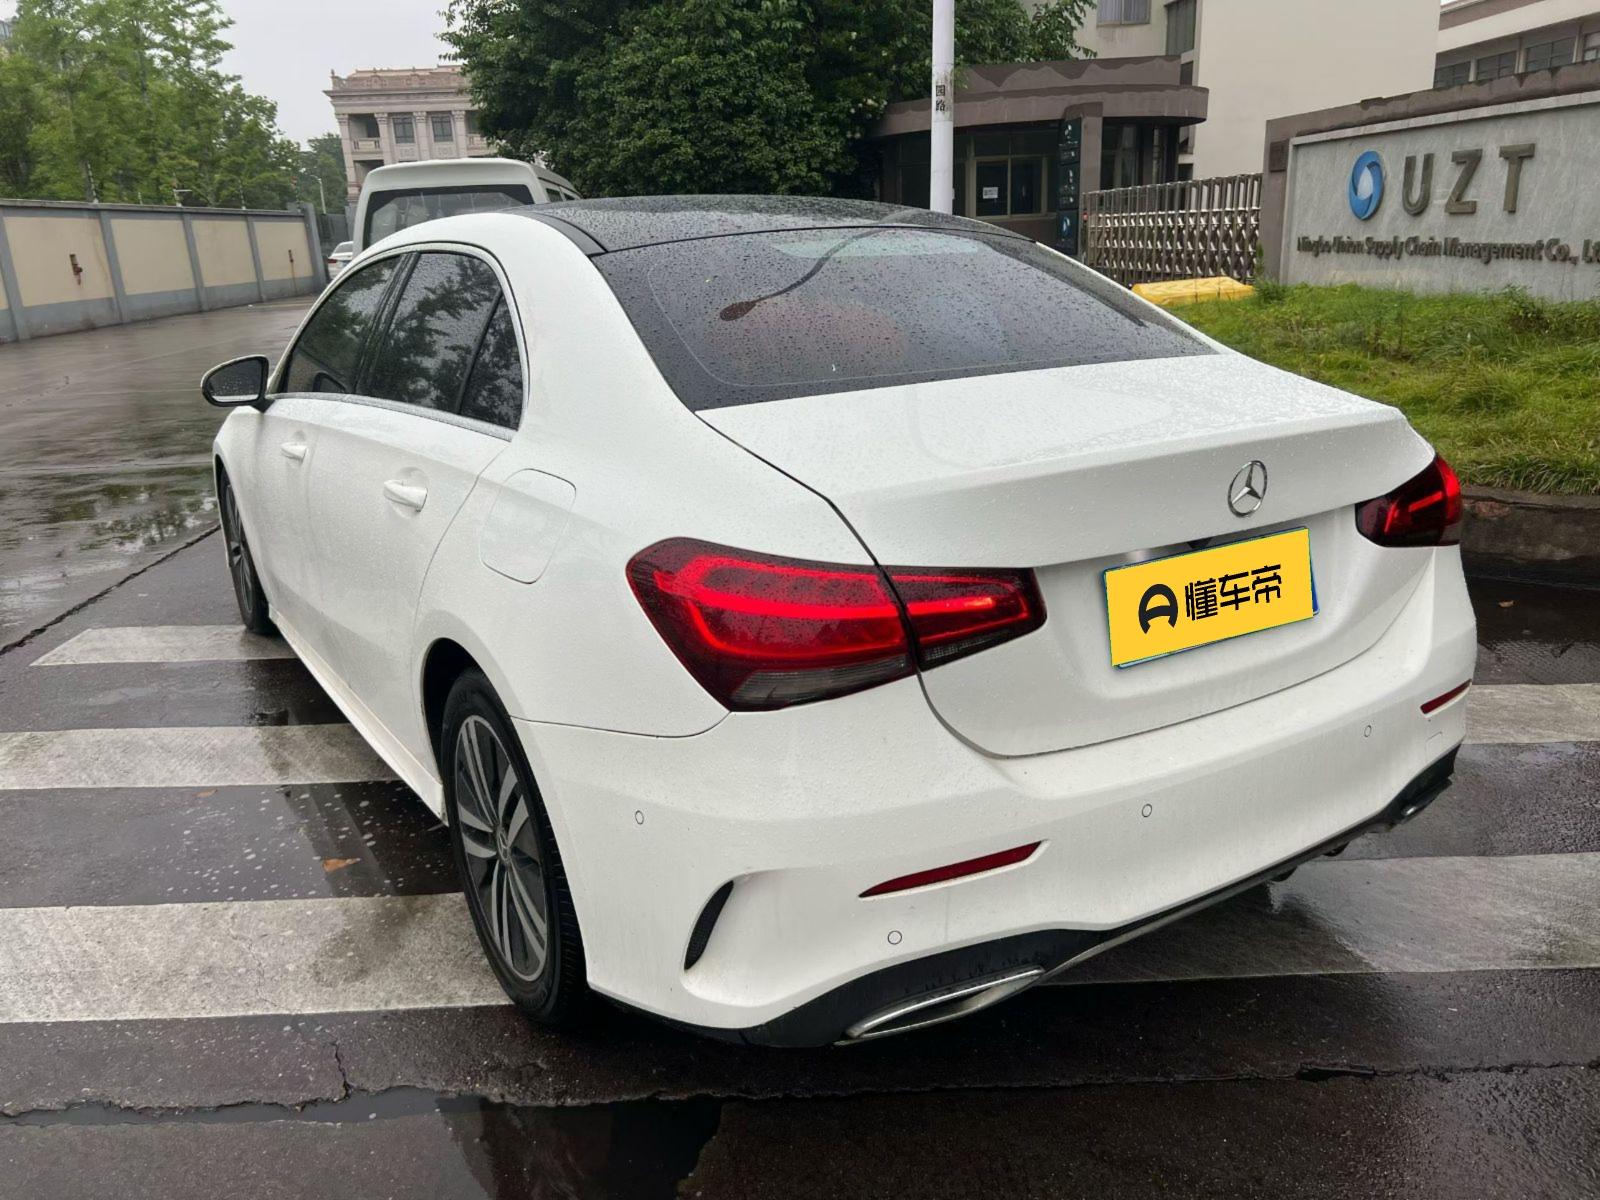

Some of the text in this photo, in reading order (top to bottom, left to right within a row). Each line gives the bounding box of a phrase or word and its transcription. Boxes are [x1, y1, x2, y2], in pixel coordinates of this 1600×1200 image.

[1365, 235, 1404, 260] Supply
[1405, 235, 1442, 257] Chain
[1444, 236, 1544, 265] Management
